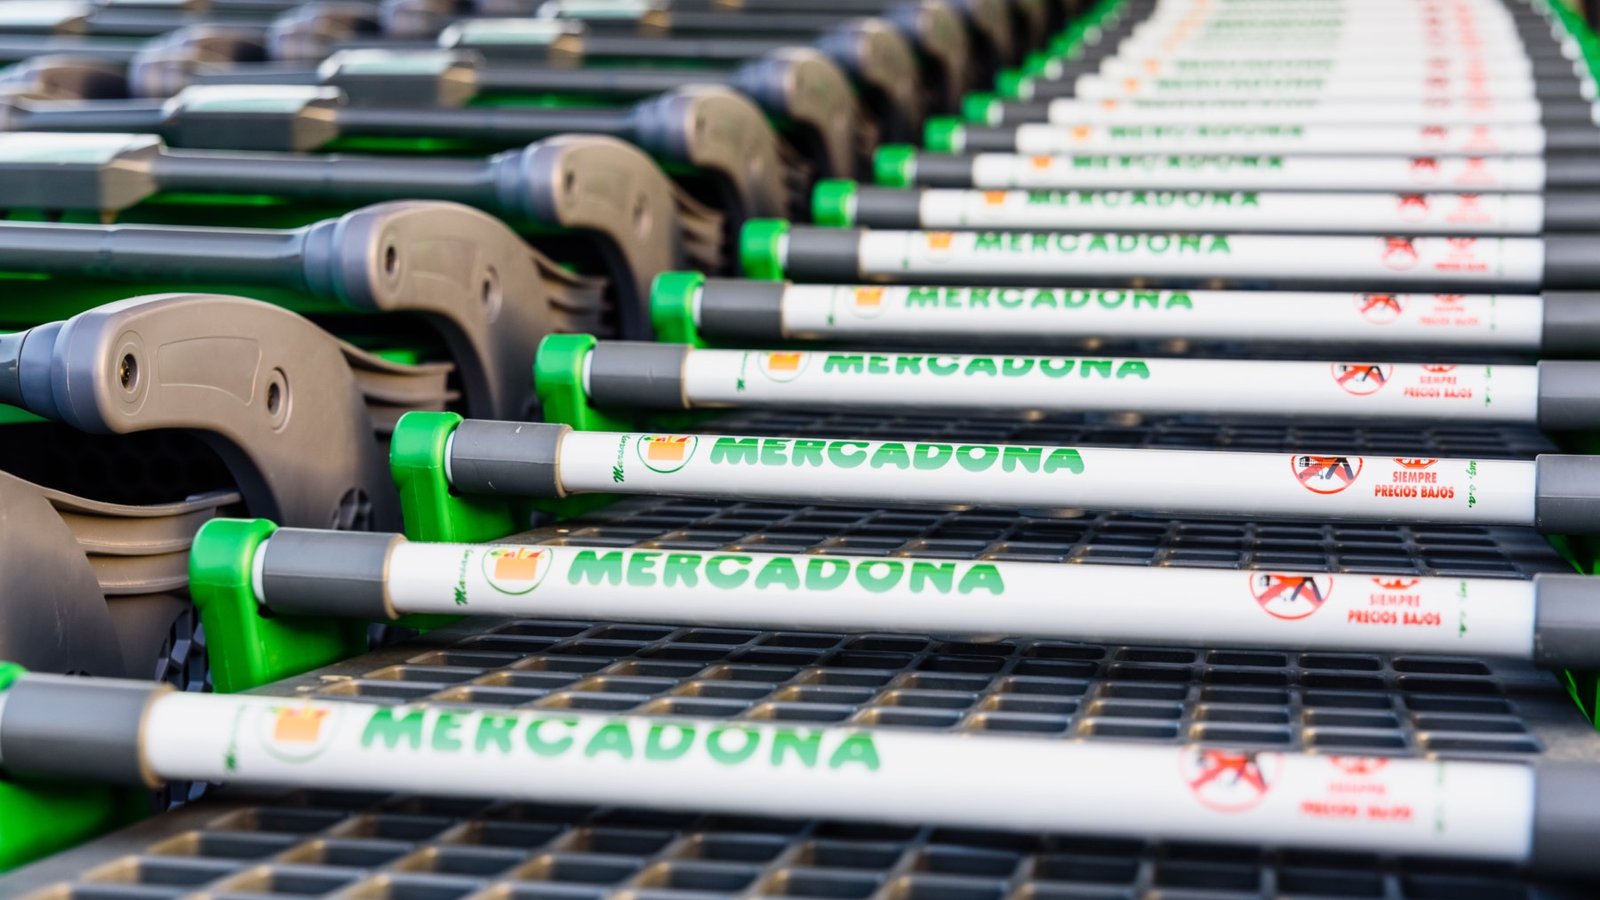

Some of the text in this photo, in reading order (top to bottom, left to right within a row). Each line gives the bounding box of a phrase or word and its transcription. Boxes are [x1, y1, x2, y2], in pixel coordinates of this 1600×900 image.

[973, 232, 1232, 254] MERCADONA
[904, 287, 1195, 311] MERCADONA
[821, 353, 1152, 380] MERCADONA
[709, 435, 1086, 475] MERCADONA
[1392, 471, 1438, 485] SIEMPRE
[1374, 484, 1456, 500] PRECIOS BAJOS
[566, 548, 1006, 596] MERCADONA
[1370, 593, 1421, 607] SIEMPRE
[1347, 608, 1442, 627] PRECIOS BAJOS
[360, 705, 881, 773] MERCADONA
